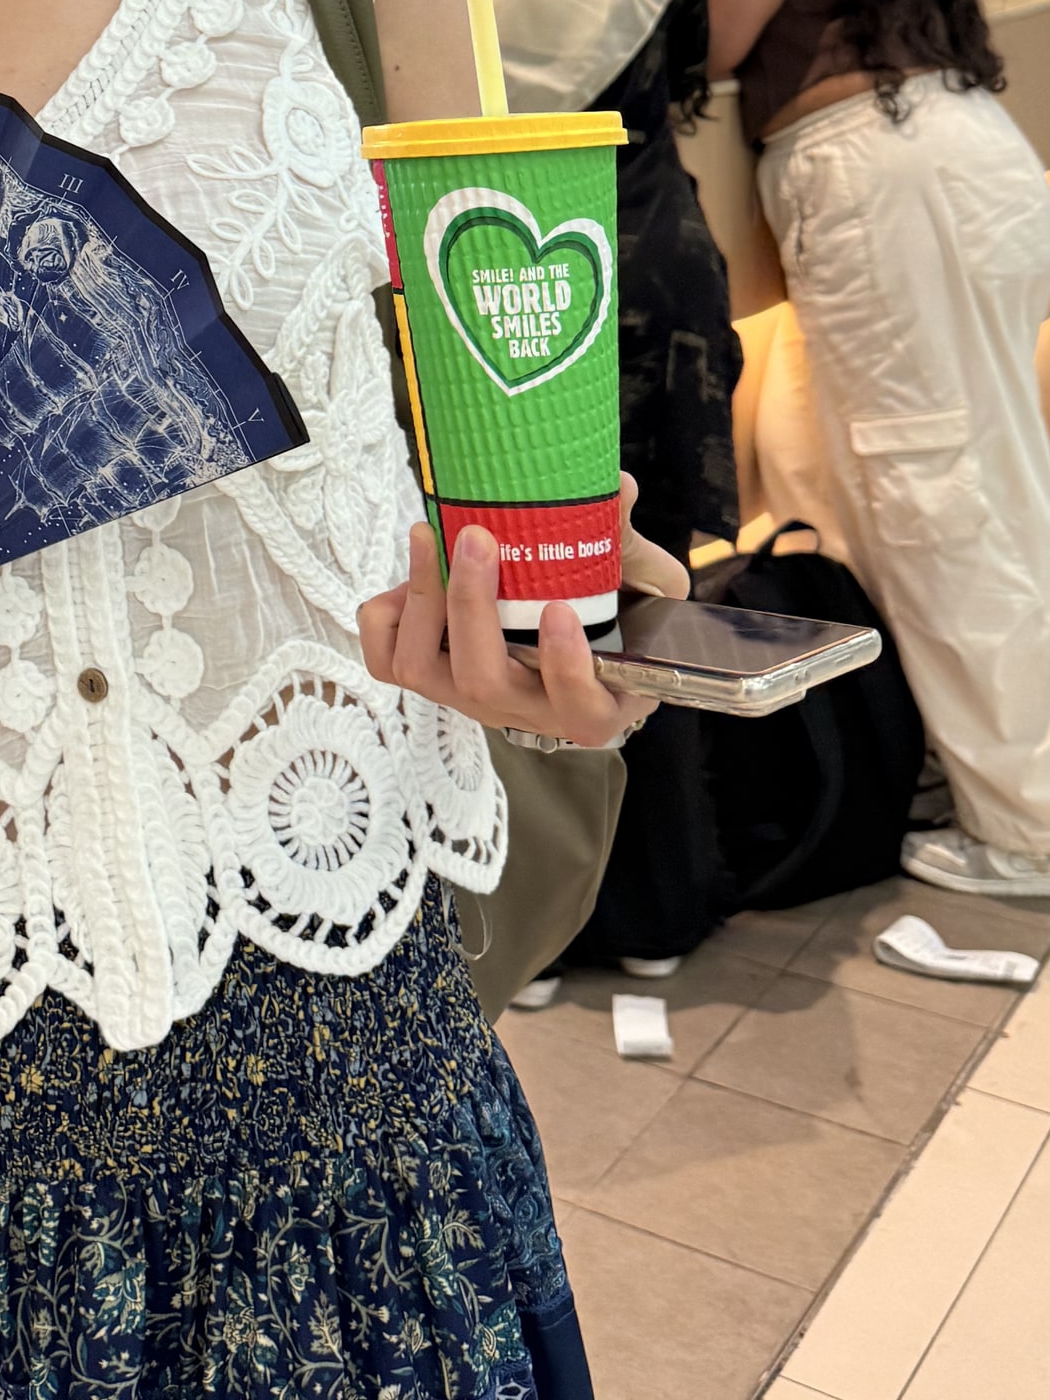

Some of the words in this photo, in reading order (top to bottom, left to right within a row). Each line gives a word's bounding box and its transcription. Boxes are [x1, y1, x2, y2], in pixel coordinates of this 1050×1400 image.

[57, 173, 84, 194] III
[471, 268, 514, 283] SMILE!
[519, 266, 545, 281] AND
[548, 263, 570, 279] THE
[472, 280, 572, 315] WORLD
[491, 312, 562, 339] SMILES
[508, 337, 551, 358] BACK
[499, 543, 533, 561] ife's
[537, 542, 575, 561] little
